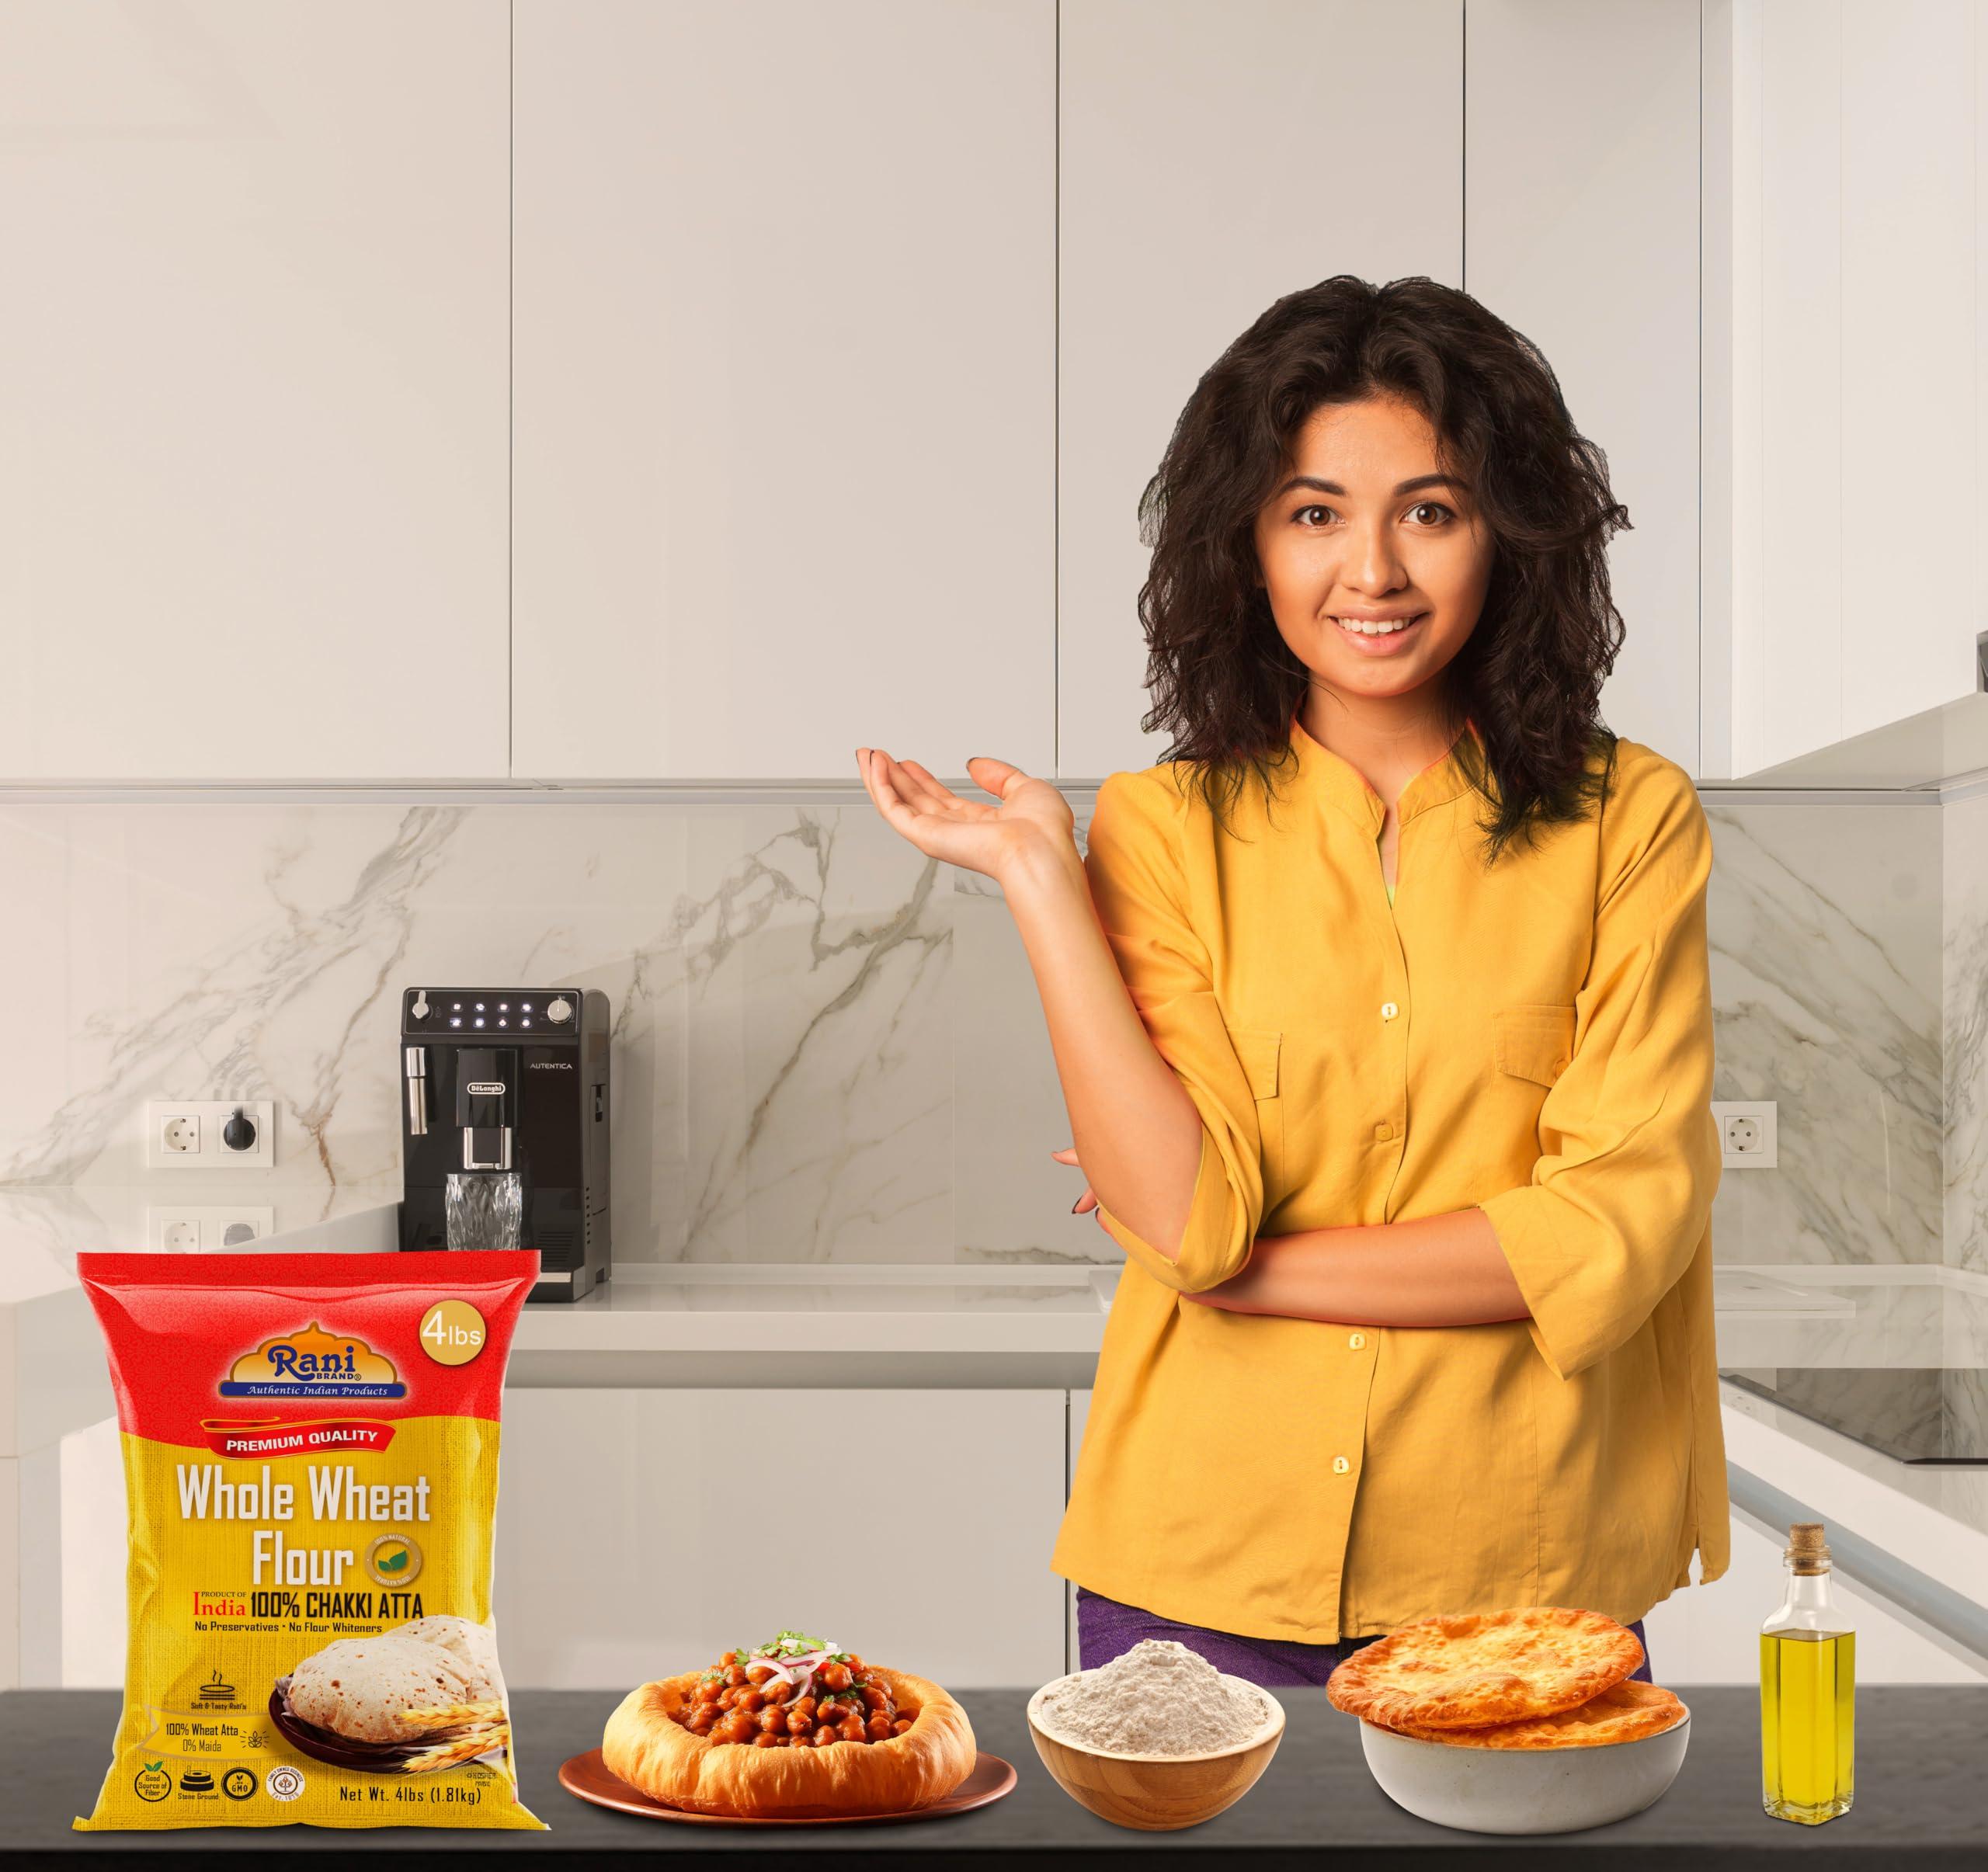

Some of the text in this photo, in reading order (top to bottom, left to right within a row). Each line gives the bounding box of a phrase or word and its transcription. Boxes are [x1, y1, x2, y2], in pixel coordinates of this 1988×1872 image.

[422, 1310, 481, 1346] 4lbs
[267, 1345, 356, 1381] Rani
[247, 1385, 388, 1396] Authentic Indian Products
[226, 1429, 378, 1452] PREMIUM QUALITY
[177, 1464, 430, 1521] Whole Wheat
[253, 1530, 354, 1586] Flour
[193, 1591, 246, 1616] India
[251, 1592, 423, 1619] 100% CHAKKI ATTA
[195, 1621, 382, 1633] No Preservatives No Flour Whiteners
[166, 1723, 238, 1736] 100% Wheat Atta
[183, 1739, 221, 1752] 0% Maida
[340, 1787, 481, 1805] Net Wt. 4lbs (1.81kg)
